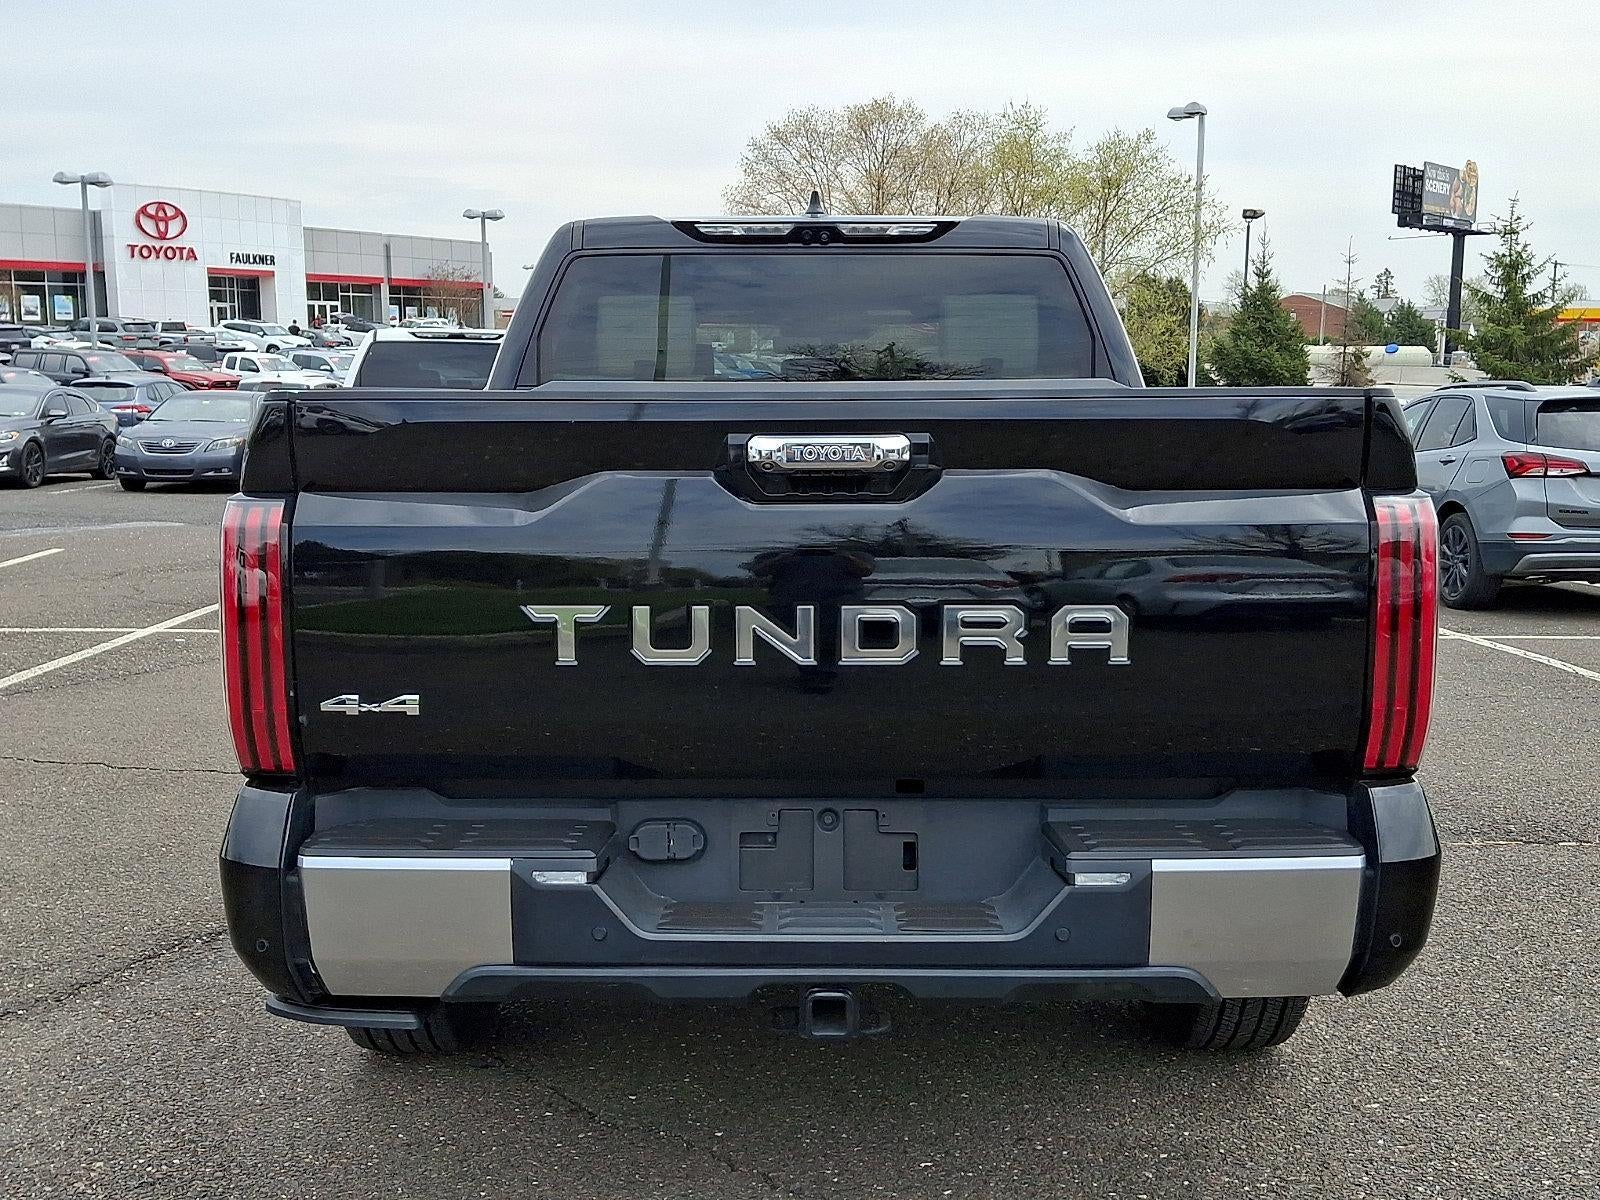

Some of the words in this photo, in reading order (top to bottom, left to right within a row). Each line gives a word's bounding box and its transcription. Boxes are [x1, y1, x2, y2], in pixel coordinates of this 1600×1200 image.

[127, 244, 198, 261] TOYOTA
[229, 252, 276, 266] FAULKNER
[791, 445, 867, 461] TOYOTA
[519, 604, 1131, 666] TUNDRA
